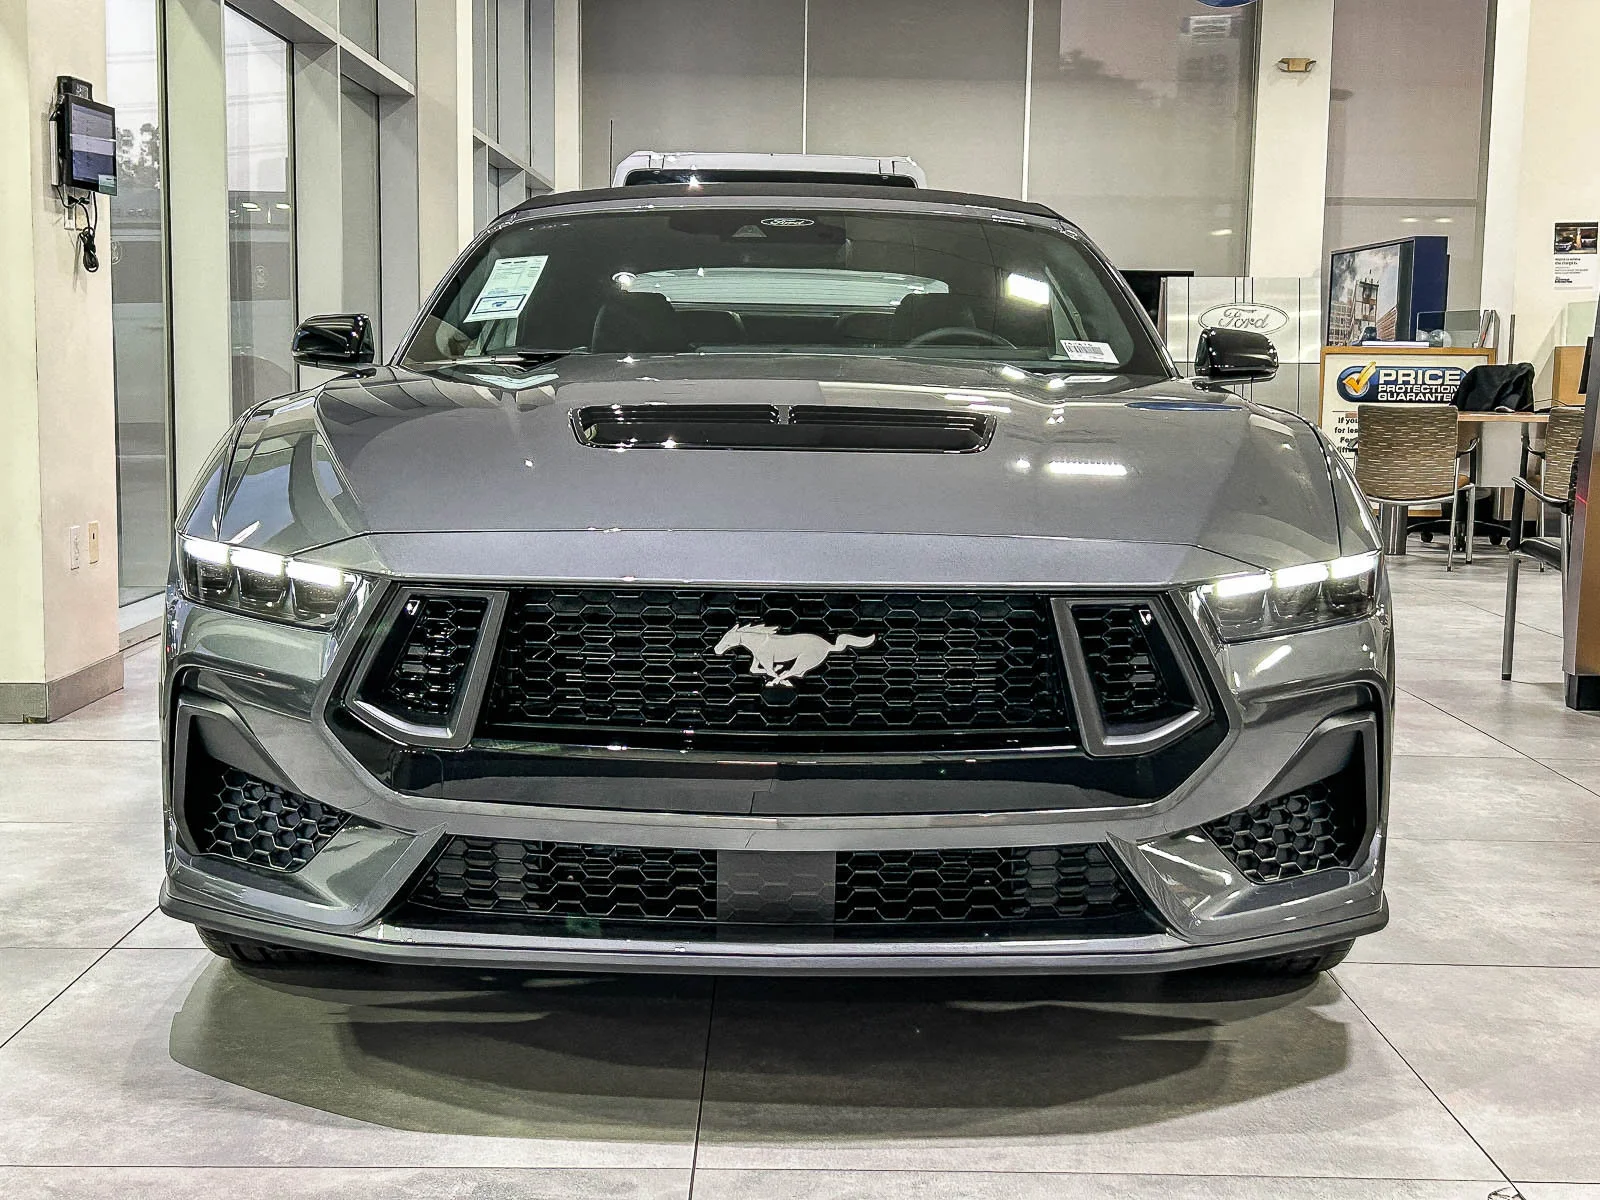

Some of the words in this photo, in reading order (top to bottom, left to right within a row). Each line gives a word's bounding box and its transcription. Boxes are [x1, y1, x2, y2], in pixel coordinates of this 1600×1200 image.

[1218, 307, 1269, 328] Ford
[1379, 369, 1460, 385] PRICE
[1378, 384, 1459, 393] PROTECTION
[1377, 392, 1455, 401] GUARANTE
